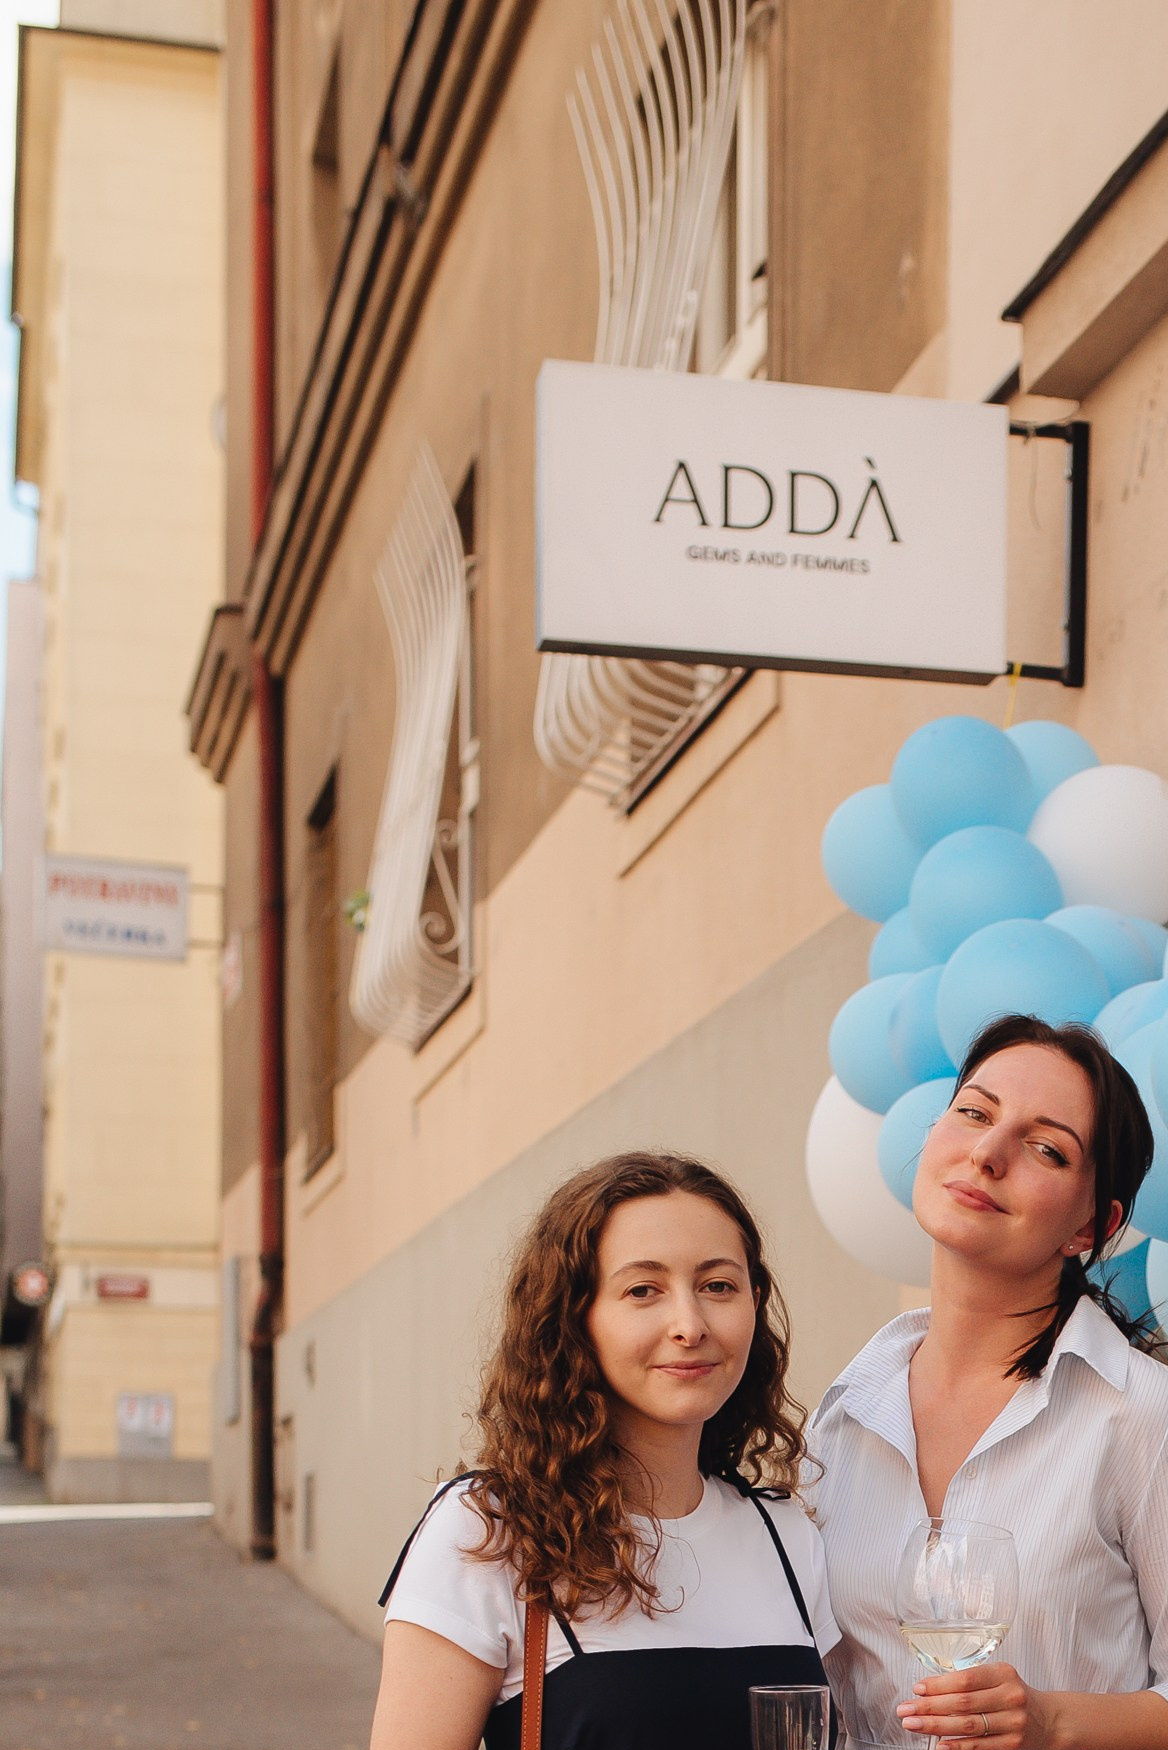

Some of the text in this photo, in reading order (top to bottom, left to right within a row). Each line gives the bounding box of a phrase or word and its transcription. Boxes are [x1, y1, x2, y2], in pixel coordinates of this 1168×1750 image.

[653, 456, 903, 543] ADDÀ
[686, 543, 872, 575] GEMS AND FEMMES
